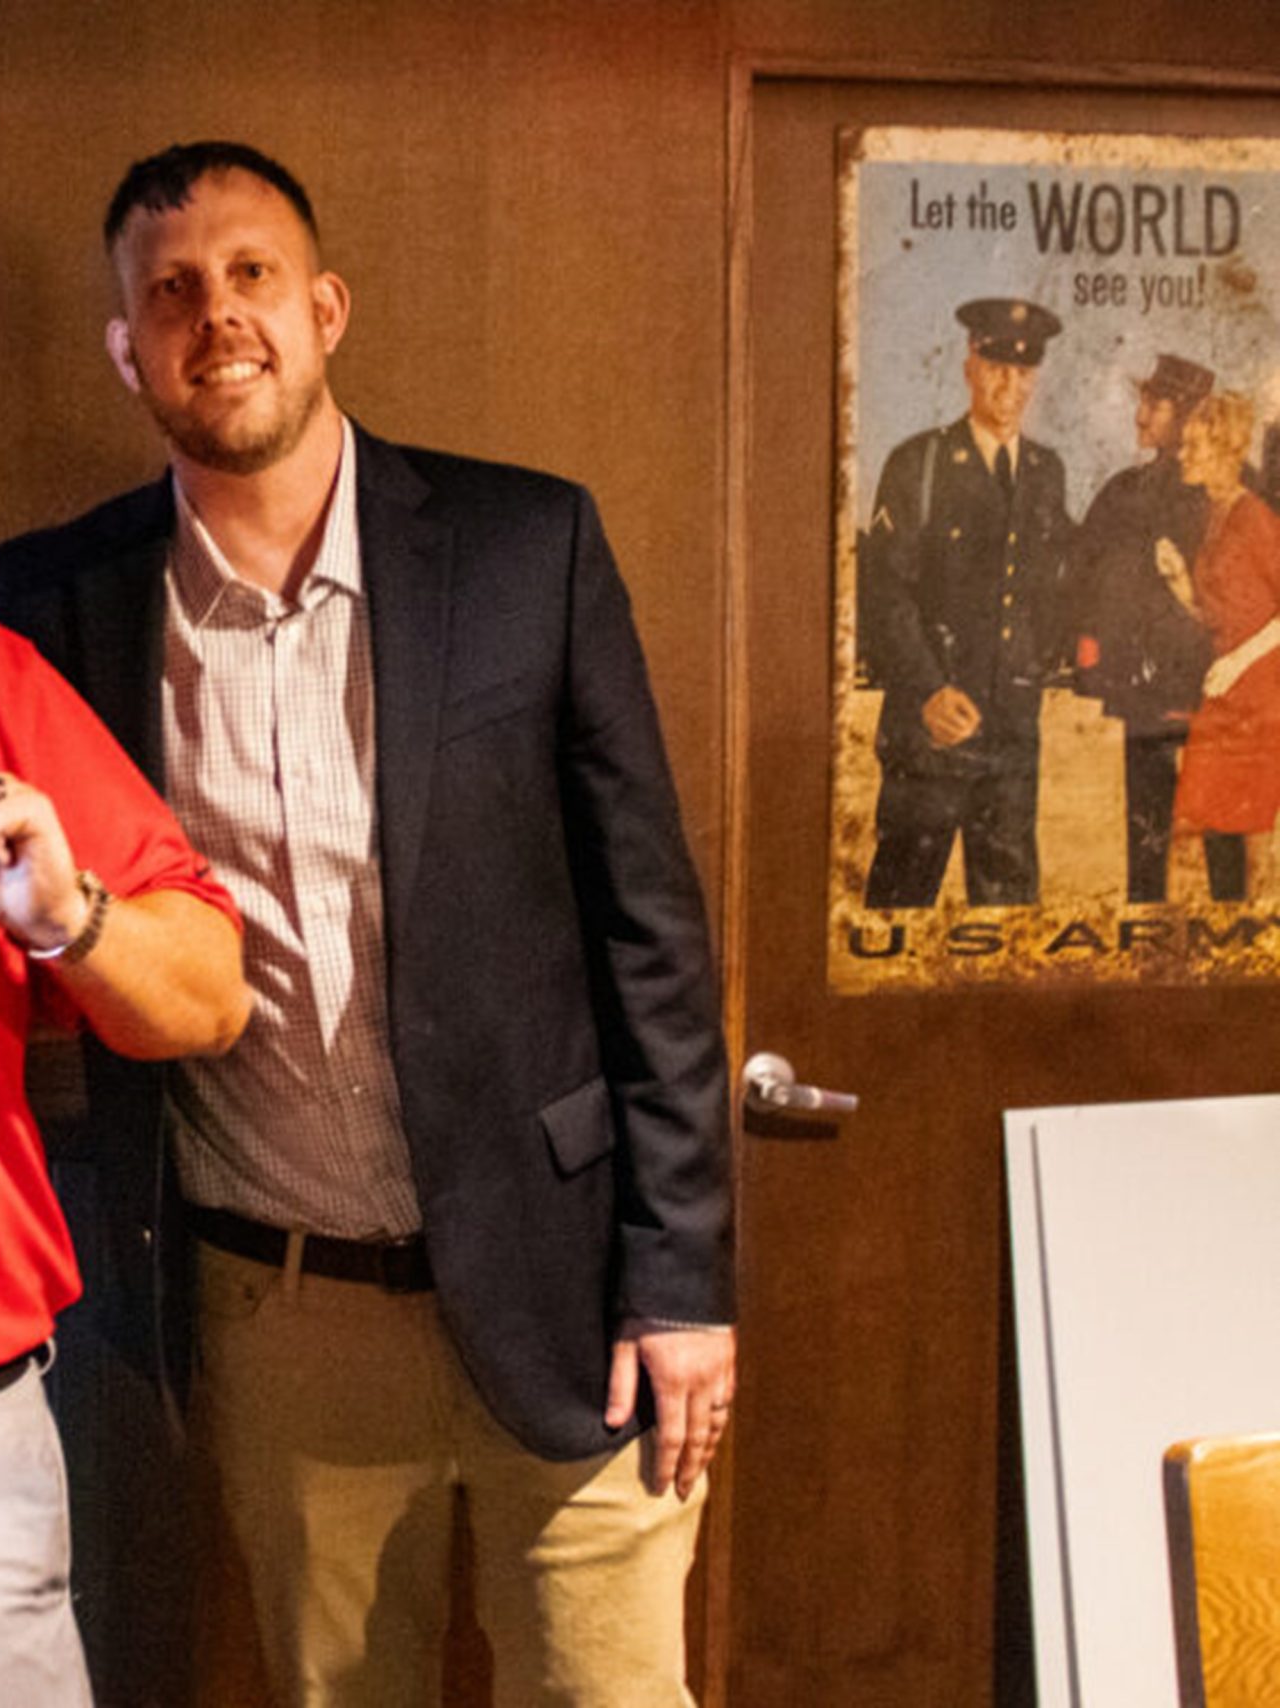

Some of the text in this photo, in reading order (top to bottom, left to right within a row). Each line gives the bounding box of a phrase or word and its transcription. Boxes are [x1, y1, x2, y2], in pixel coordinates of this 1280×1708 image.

[910, 179, 1240, 257] Let the WORLD
[1073, 263, 1207, 315] see you!
[1044, 918, 1280, 956] ARM
